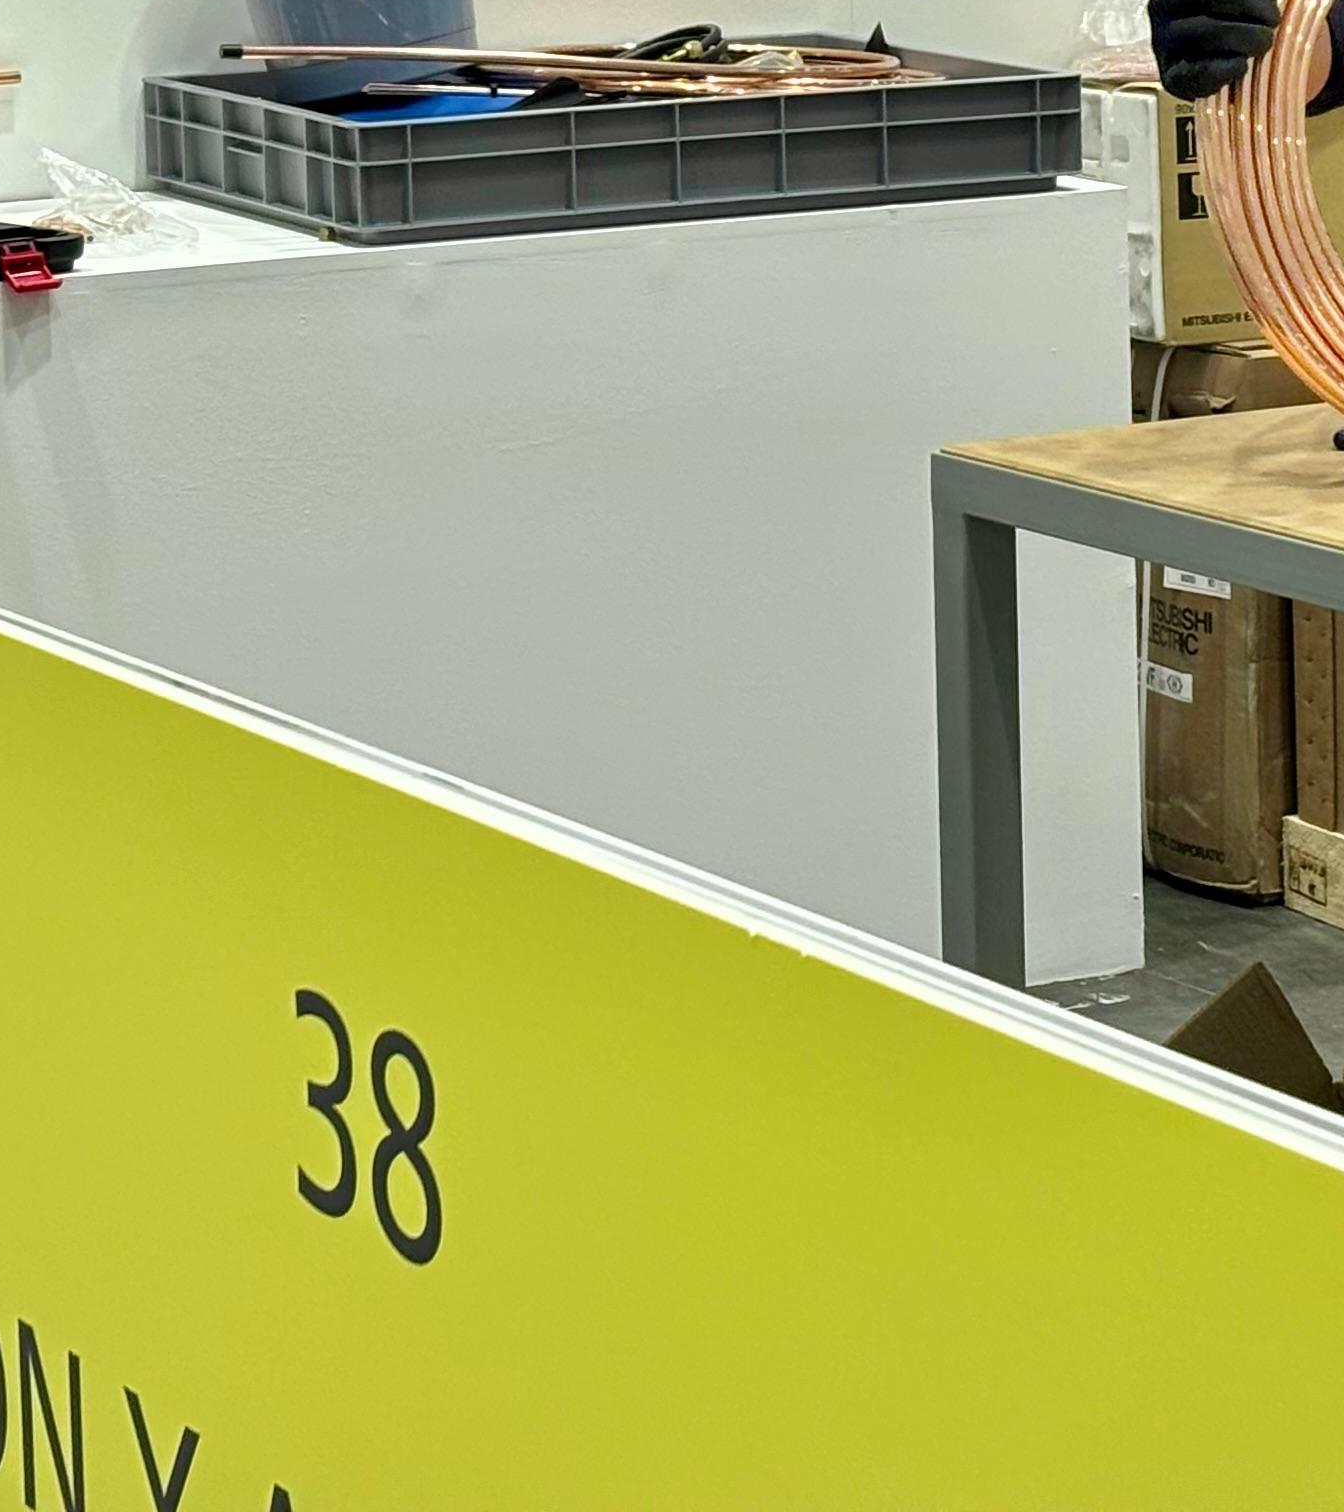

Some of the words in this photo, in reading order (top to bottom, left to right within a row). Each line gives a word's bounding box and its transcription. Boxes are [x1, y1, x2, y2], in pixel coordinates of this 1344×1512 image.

[1182, 311, 1242, 327] MITSUBISHI
[1149, 594, 1213, 635] TSUBISHI
[295, 989, 442, 1266] 38
